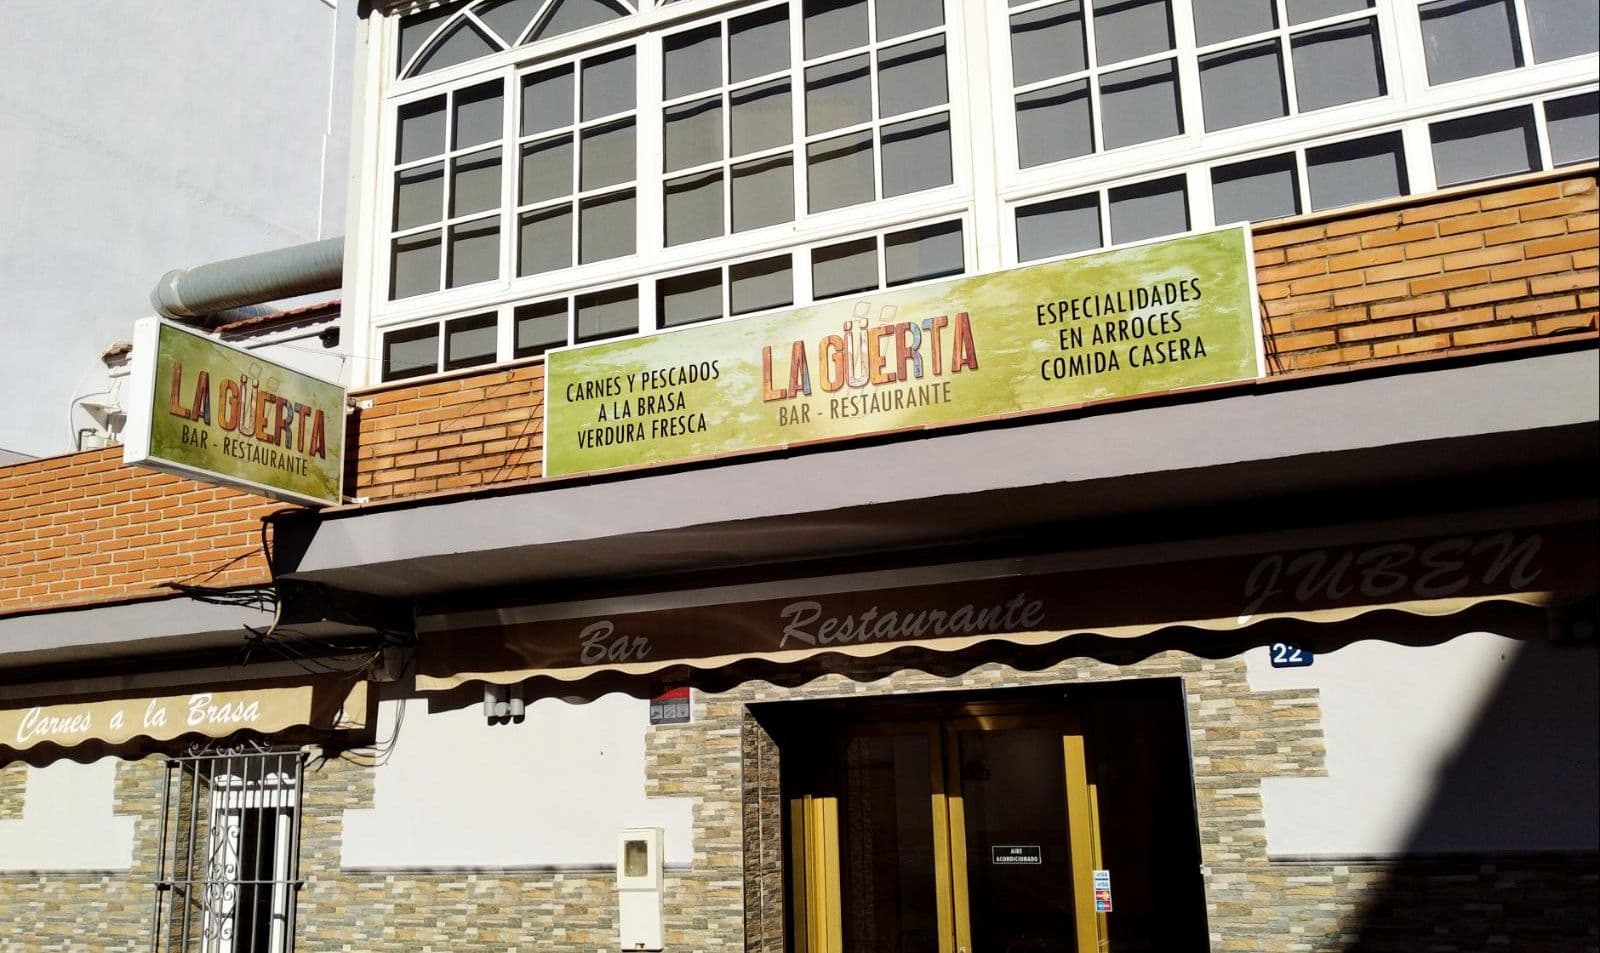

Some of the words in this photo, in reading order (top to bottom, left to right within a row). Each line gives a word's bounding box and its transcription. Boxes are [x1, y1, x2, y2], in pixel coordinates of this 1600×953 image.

[1036, 278, 1202, 326] ESPECIALIDADES
[1059, 327, 1082, 350] EN
[1092, 311, 1182, 345] ARROCES
[762, 340, 812, 403] LA
[819, 312, 979, 392] GÜERTA
[1041, 350, 1120, 381] COMIDA
[1128, 336, 1207, 368] CASERA
[566, 377, 621, 403] CARNES
[628, 374, 636, 392] Y
[641, 360, 720, 391] PESCADOS
[779, 403, 811, 427] BAR
[830, 382, 952, 419] RESTAURANTE
[169, 362, 211, 426] LA
[218, 374, 326, 459] GÜERTA
[598, 403, 608, 422] A
[613, 401, 631, 420] LA
[638, 391, 686, 416] BRASA
[181, 424, 209, 450] BAR
[223, 436, 309, 476] RESTAURANTE
[577, 423, 646, 450] VERDURA
[651, 413, 707, 439] FRESCA
[1238, 533, 1543, 624] JUBEN
[578, 620, 653, 665] Bar
[779, 592, 1046, 648] Restaurante
[1272, 643, 1303, 663] 22
[16, 707, 92, 743] Carnes
[110, 710, 125, 730] a
[143, 698, 167, 728] la
[187, 692, 261, 725] Brasa
